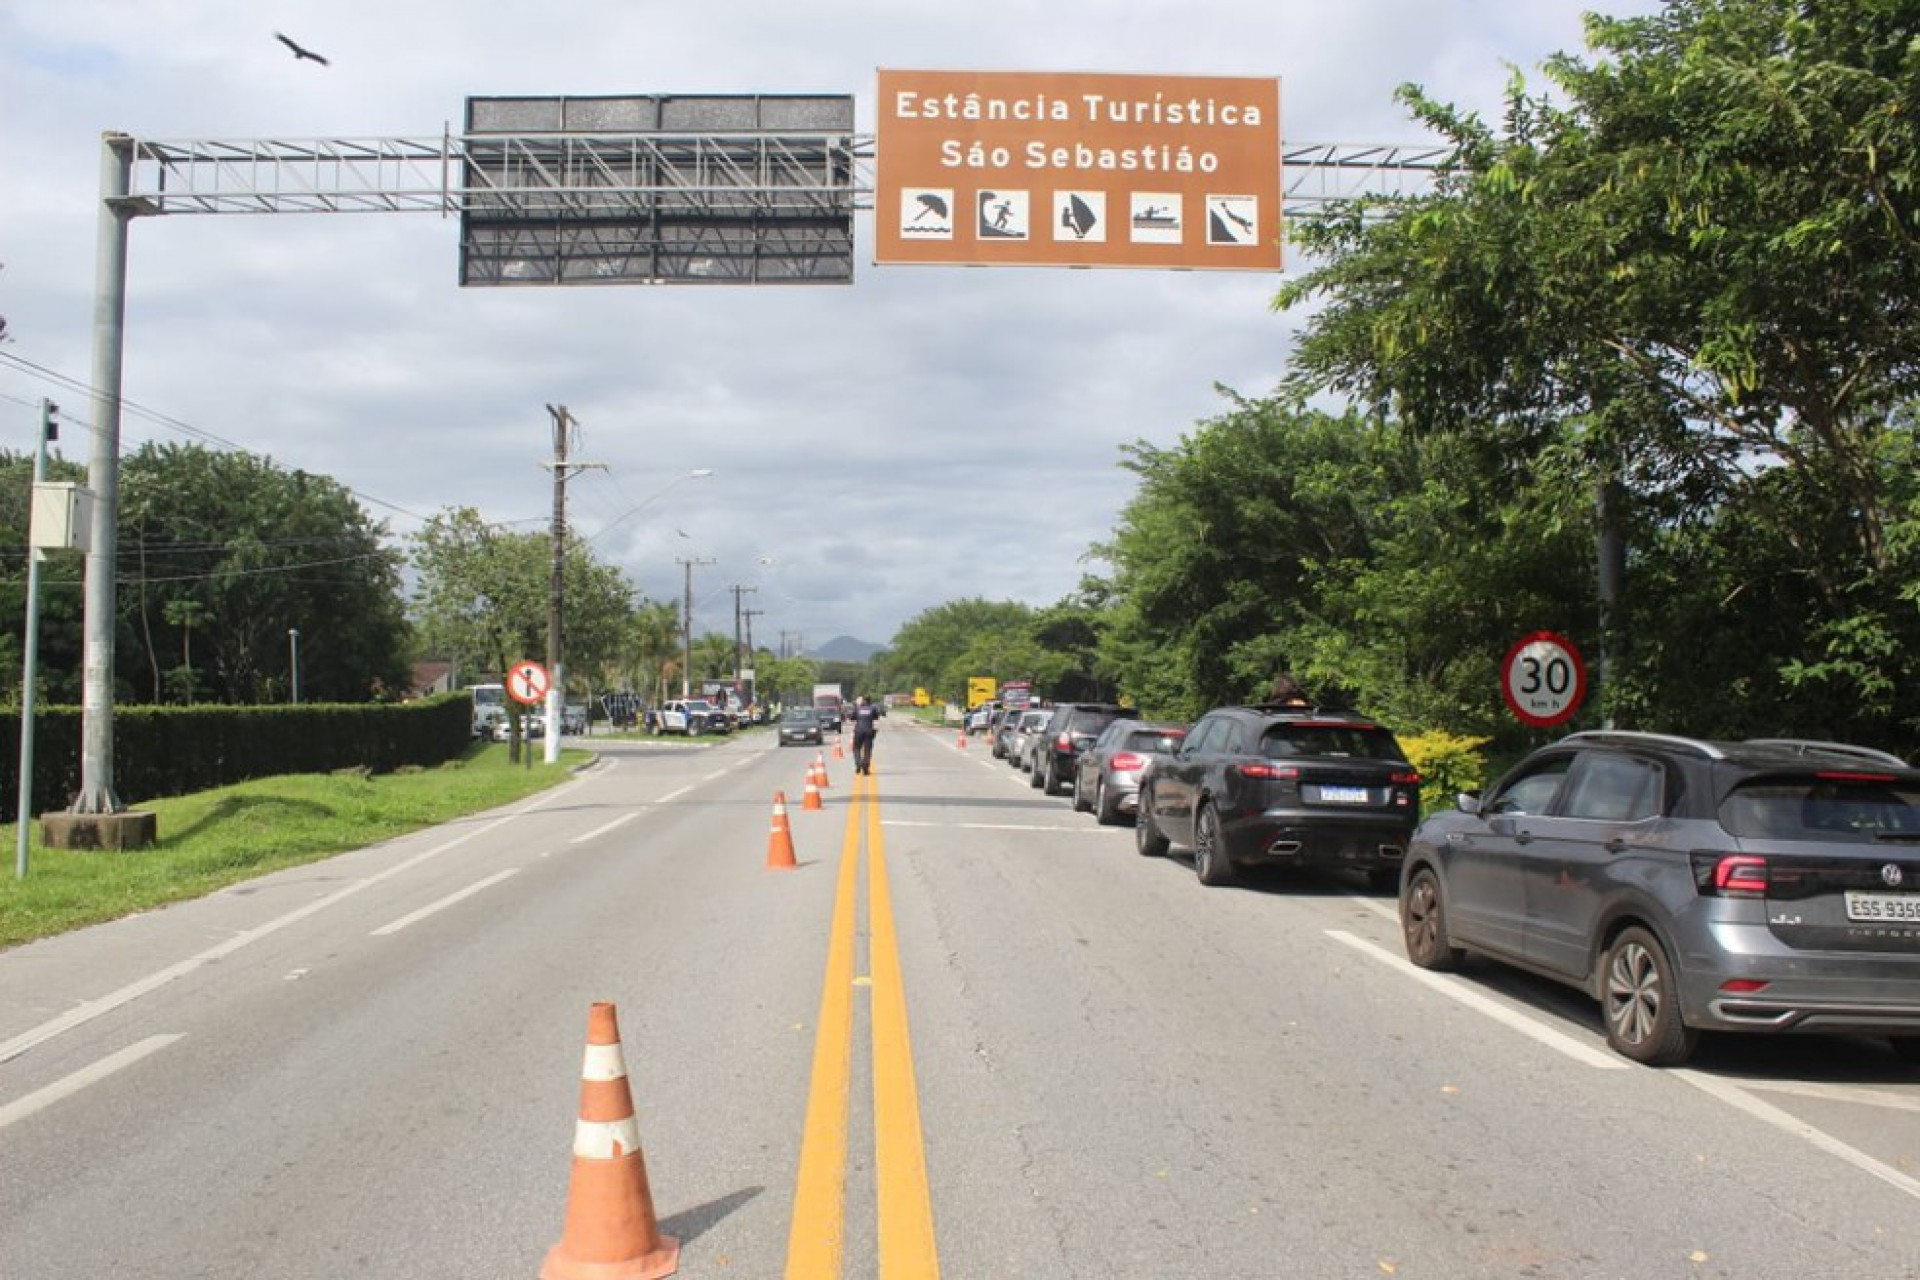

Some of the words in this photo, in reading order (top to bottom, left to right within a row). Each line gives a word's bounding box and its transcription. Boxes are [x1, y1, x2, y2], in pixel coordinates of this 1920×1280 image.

[896, 91, 1069, 120] Estância
[1082, 91, 1261, 126] Turística
[1521, 657, 1569, 695] 30
